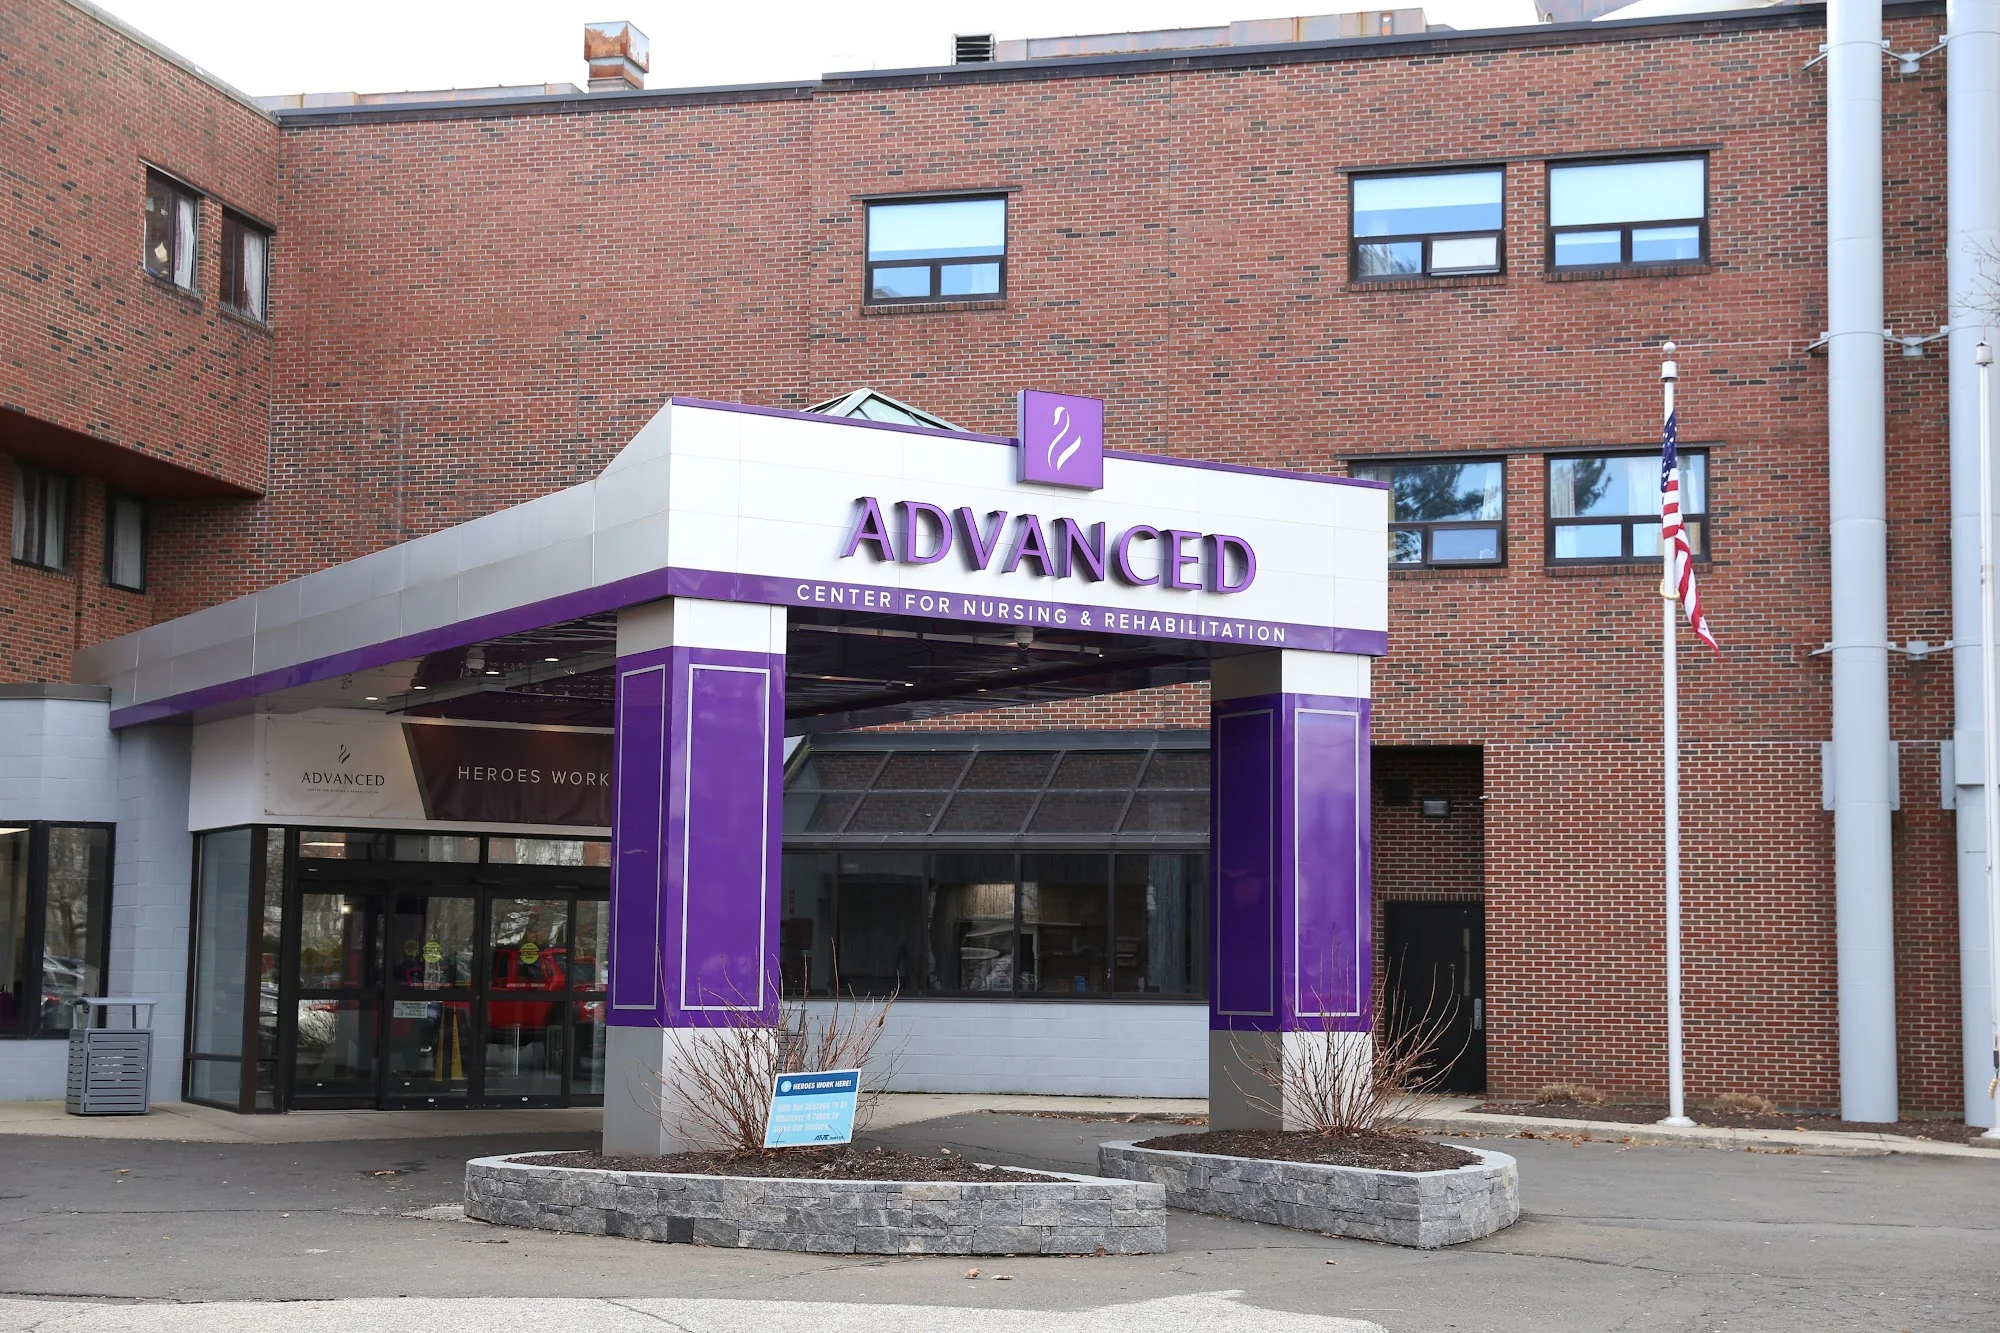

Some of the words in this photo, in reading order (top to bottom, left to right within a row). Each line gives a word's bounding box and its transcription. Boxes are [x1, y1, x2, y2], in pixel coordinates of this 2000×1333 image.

[840, 496, 1257, 594] ADVANCED
[796, 584, 892, 608] CENTER
[904, 594, 950, 614] FOR
[963, 599, 1067, 625] NURSING
[1080, 610, 1092, 627] &
[1104, 612, 1286, 643] REHABILITATION
[301, 772, 385, 786] ADVANCED
[458, 765, 541, 783] HEROES
[551, 770, 610, 787] WORK
[793, 1082, 816, 1090] HEROES
[816, 1081, 834, 1089] WORK
[835, 1080, 851, 1088] HERE!
[804, 1101, 830, 1110] Courage
[776, 1113, 805, 1122] Whatever
[812, 1112, 831, 1120] Takes
